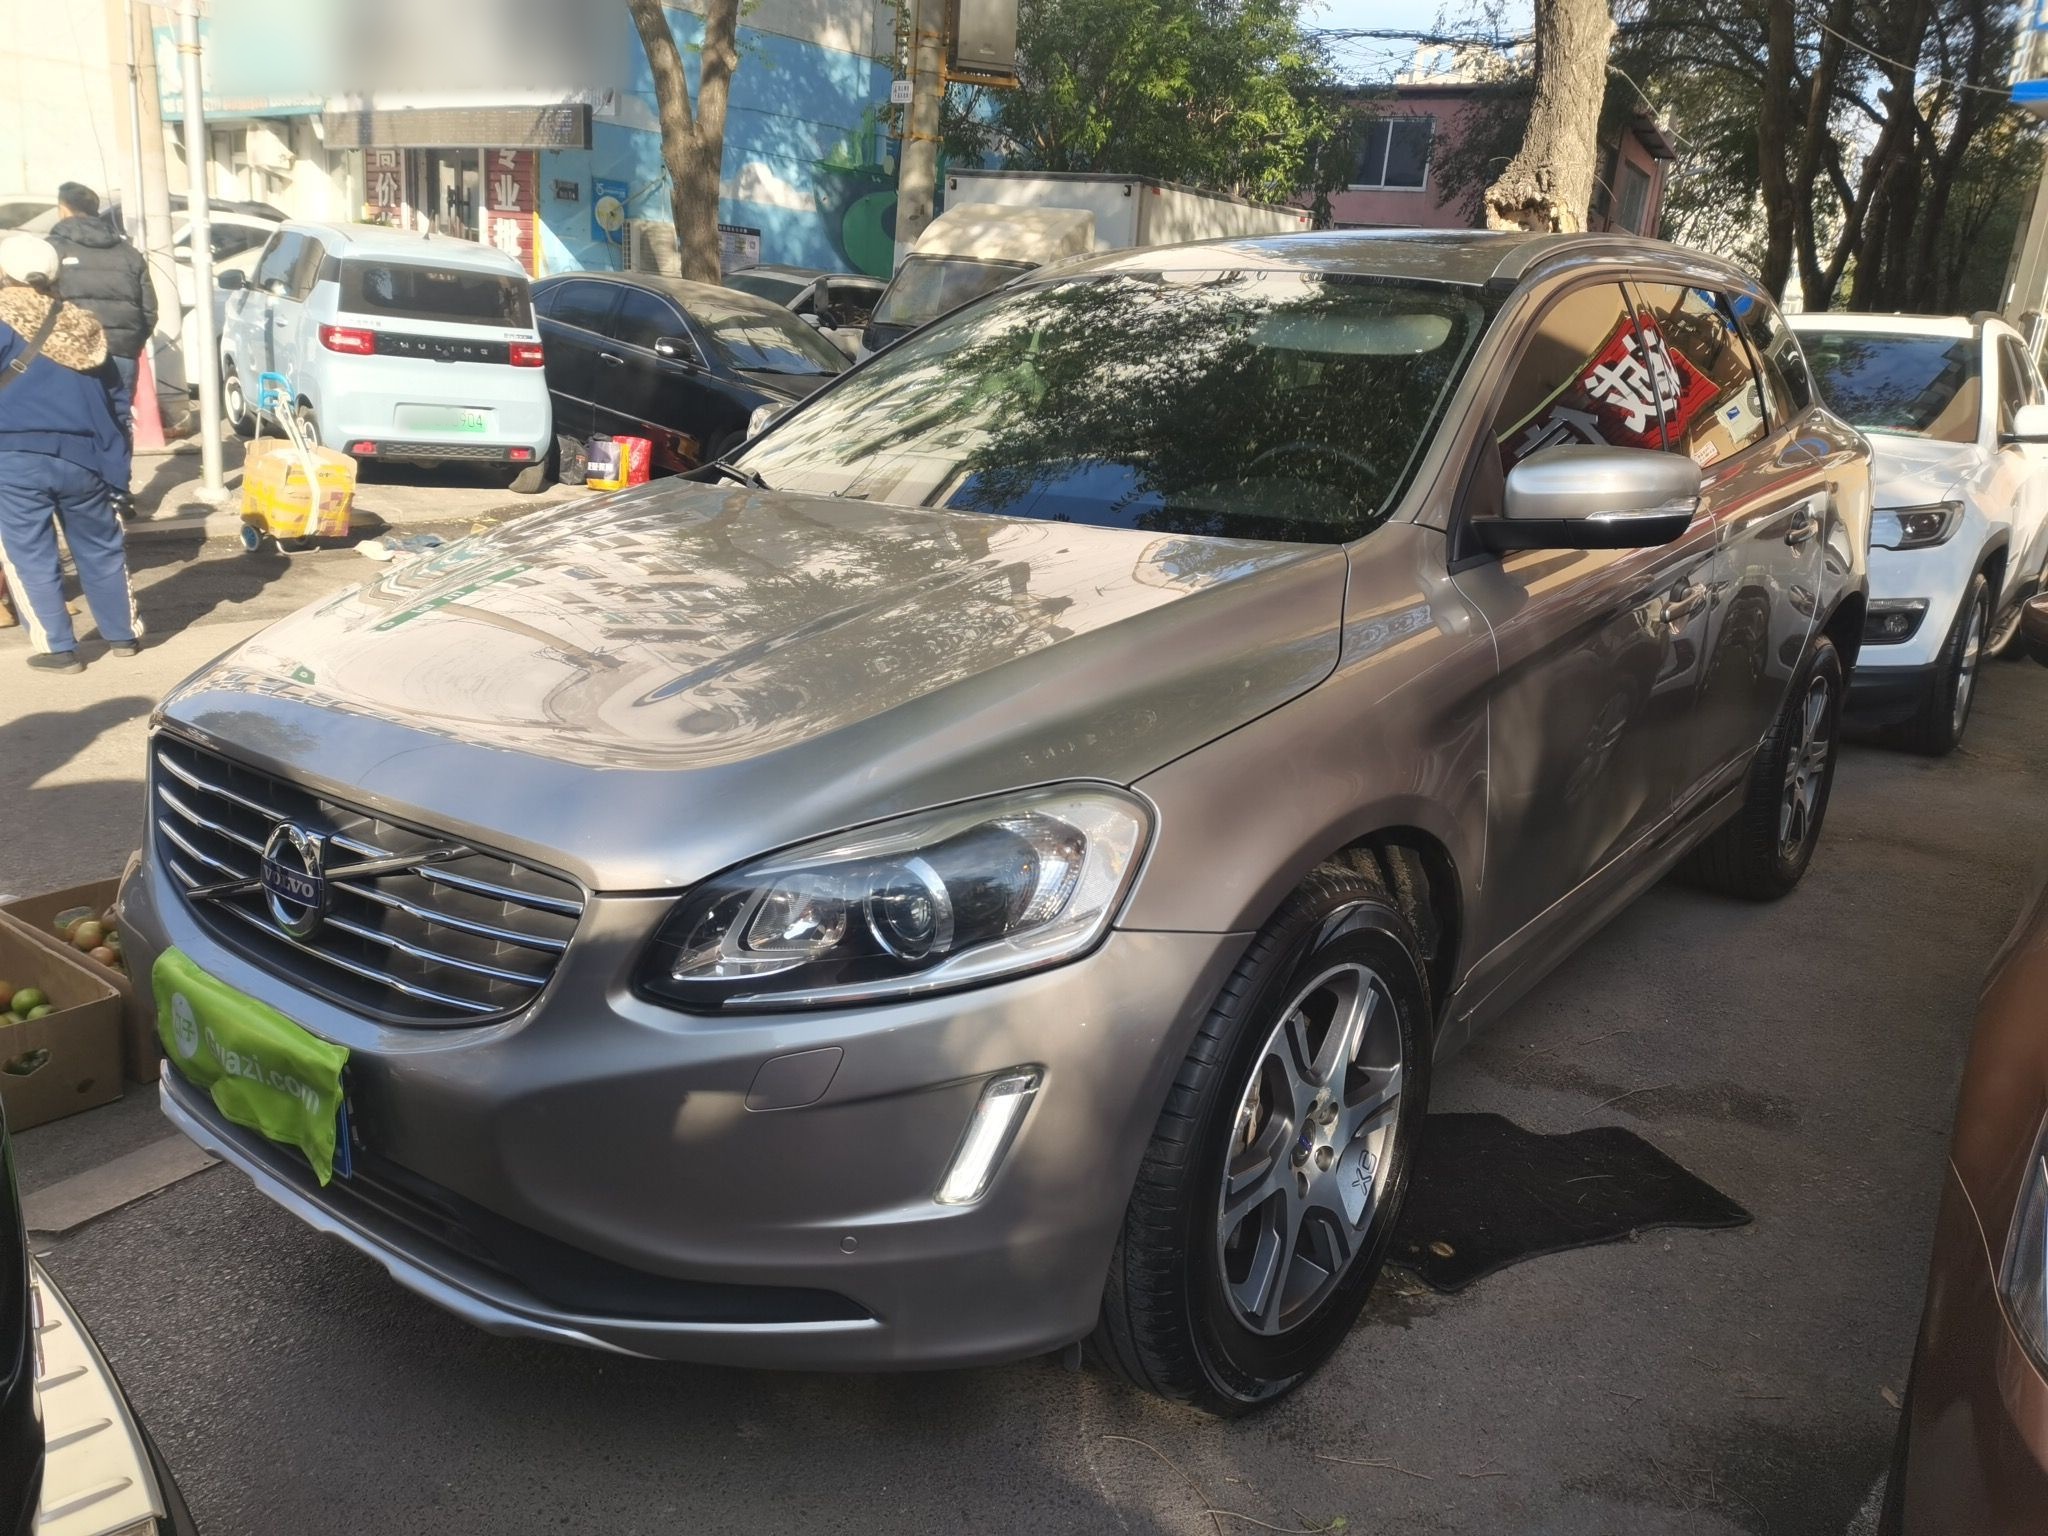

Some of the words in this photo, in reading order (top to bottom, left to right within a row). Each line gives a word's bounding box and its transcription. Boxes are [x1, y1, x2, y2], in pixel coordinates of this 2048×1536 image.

[400, 341, 489, 356] WULING
[263, 864, 315, 898] VOLVO
[1351, 1149, 1377, 1197] XC
